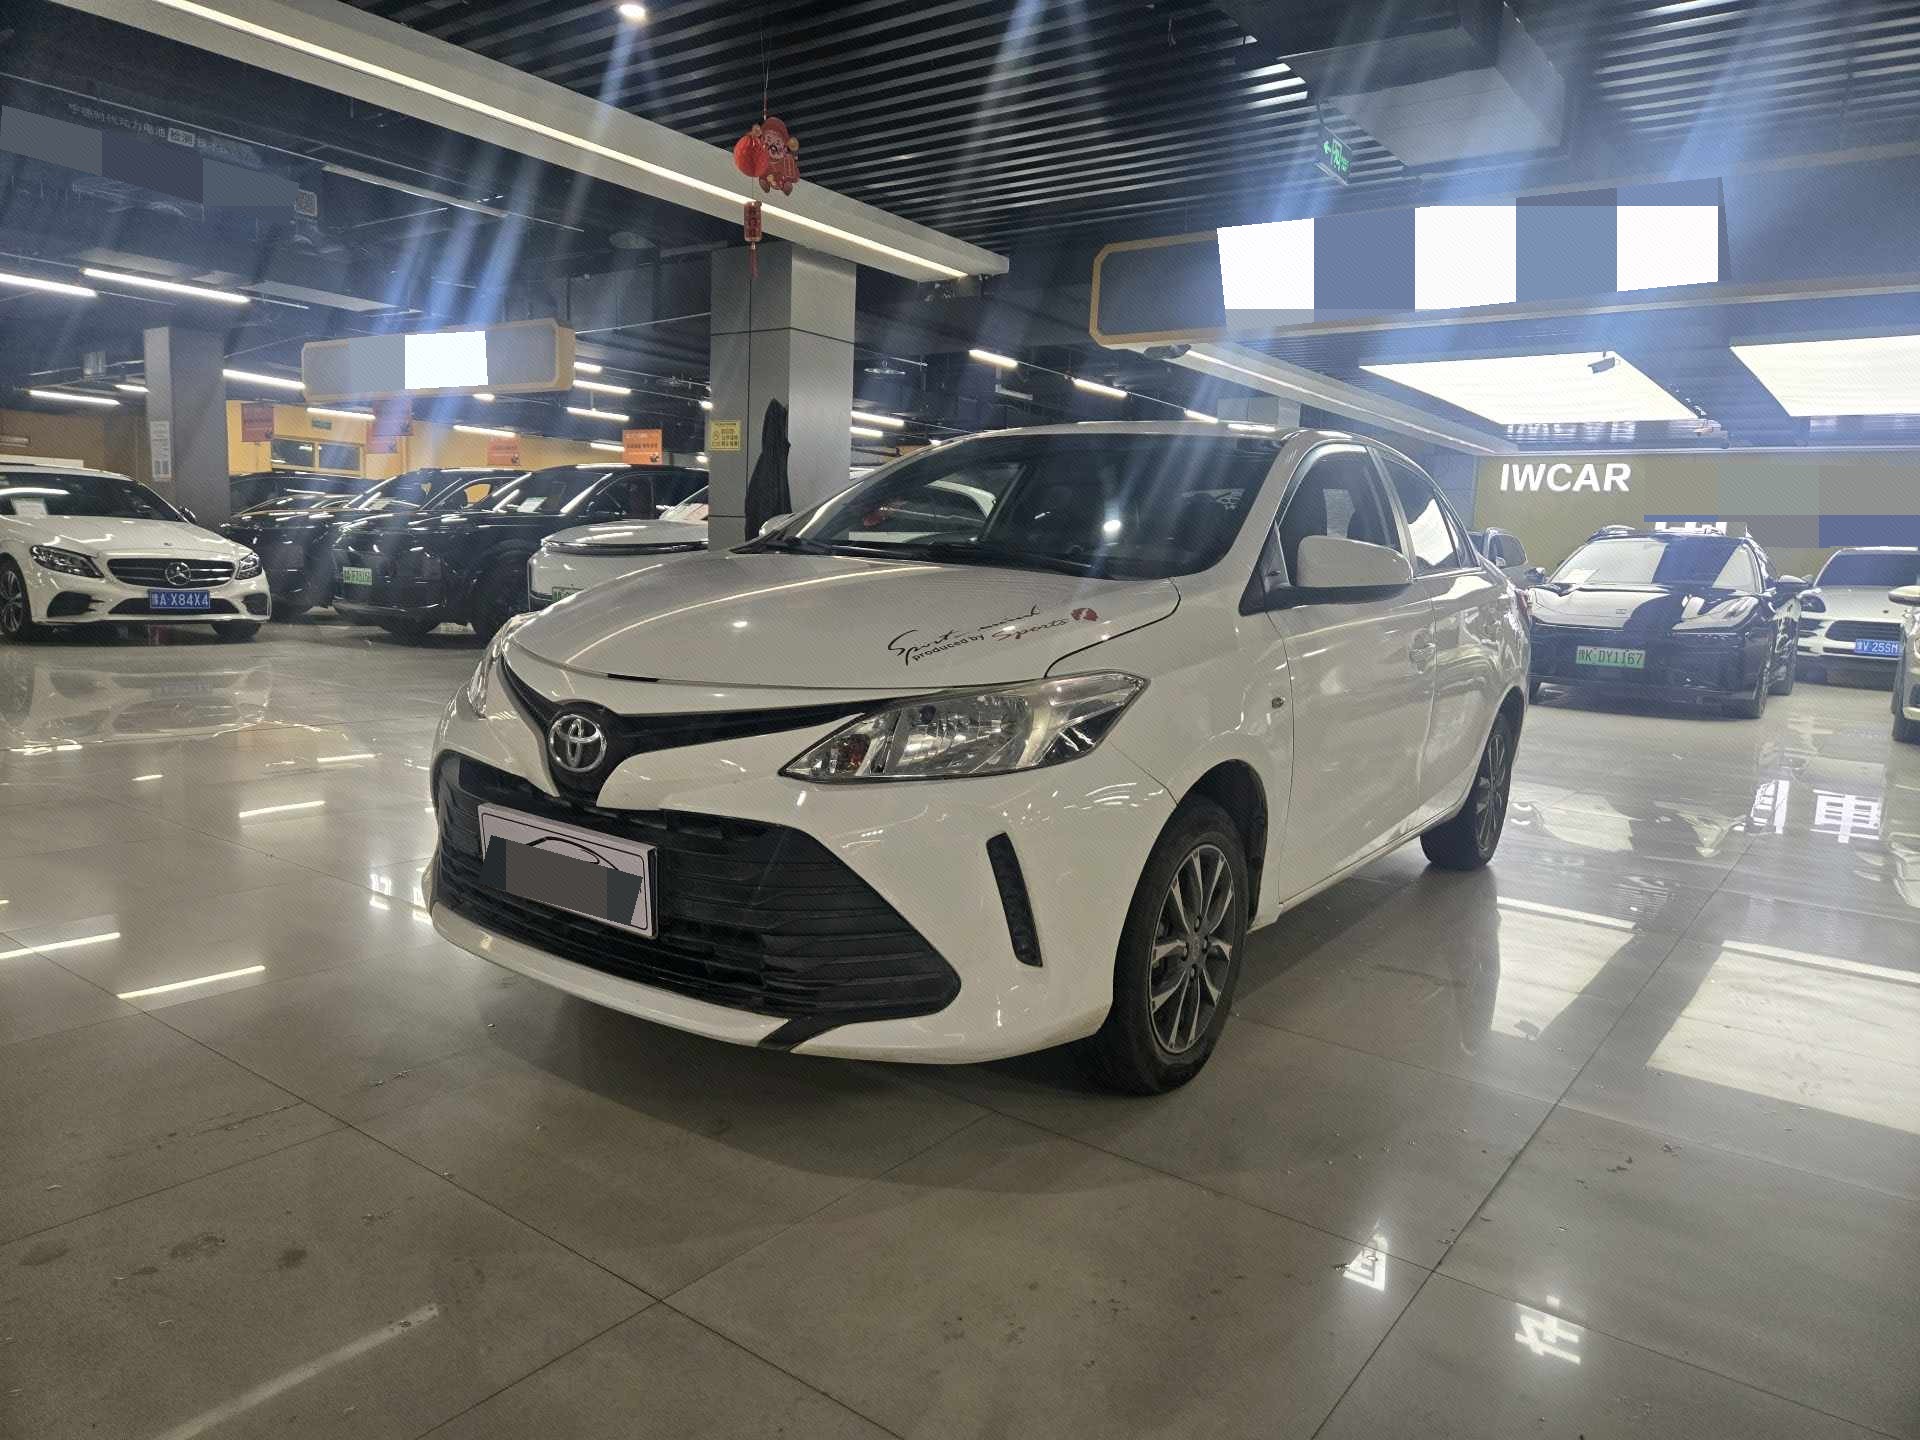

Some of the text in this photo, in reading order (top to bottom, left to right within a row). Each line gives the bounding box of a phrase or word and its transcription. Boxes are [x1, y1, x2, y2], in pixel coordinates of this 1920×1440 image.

[1500, 463, 1632, 492] IWCAR
[912, 637, 968, 661] produced
[968, 634, 985, 642] by
